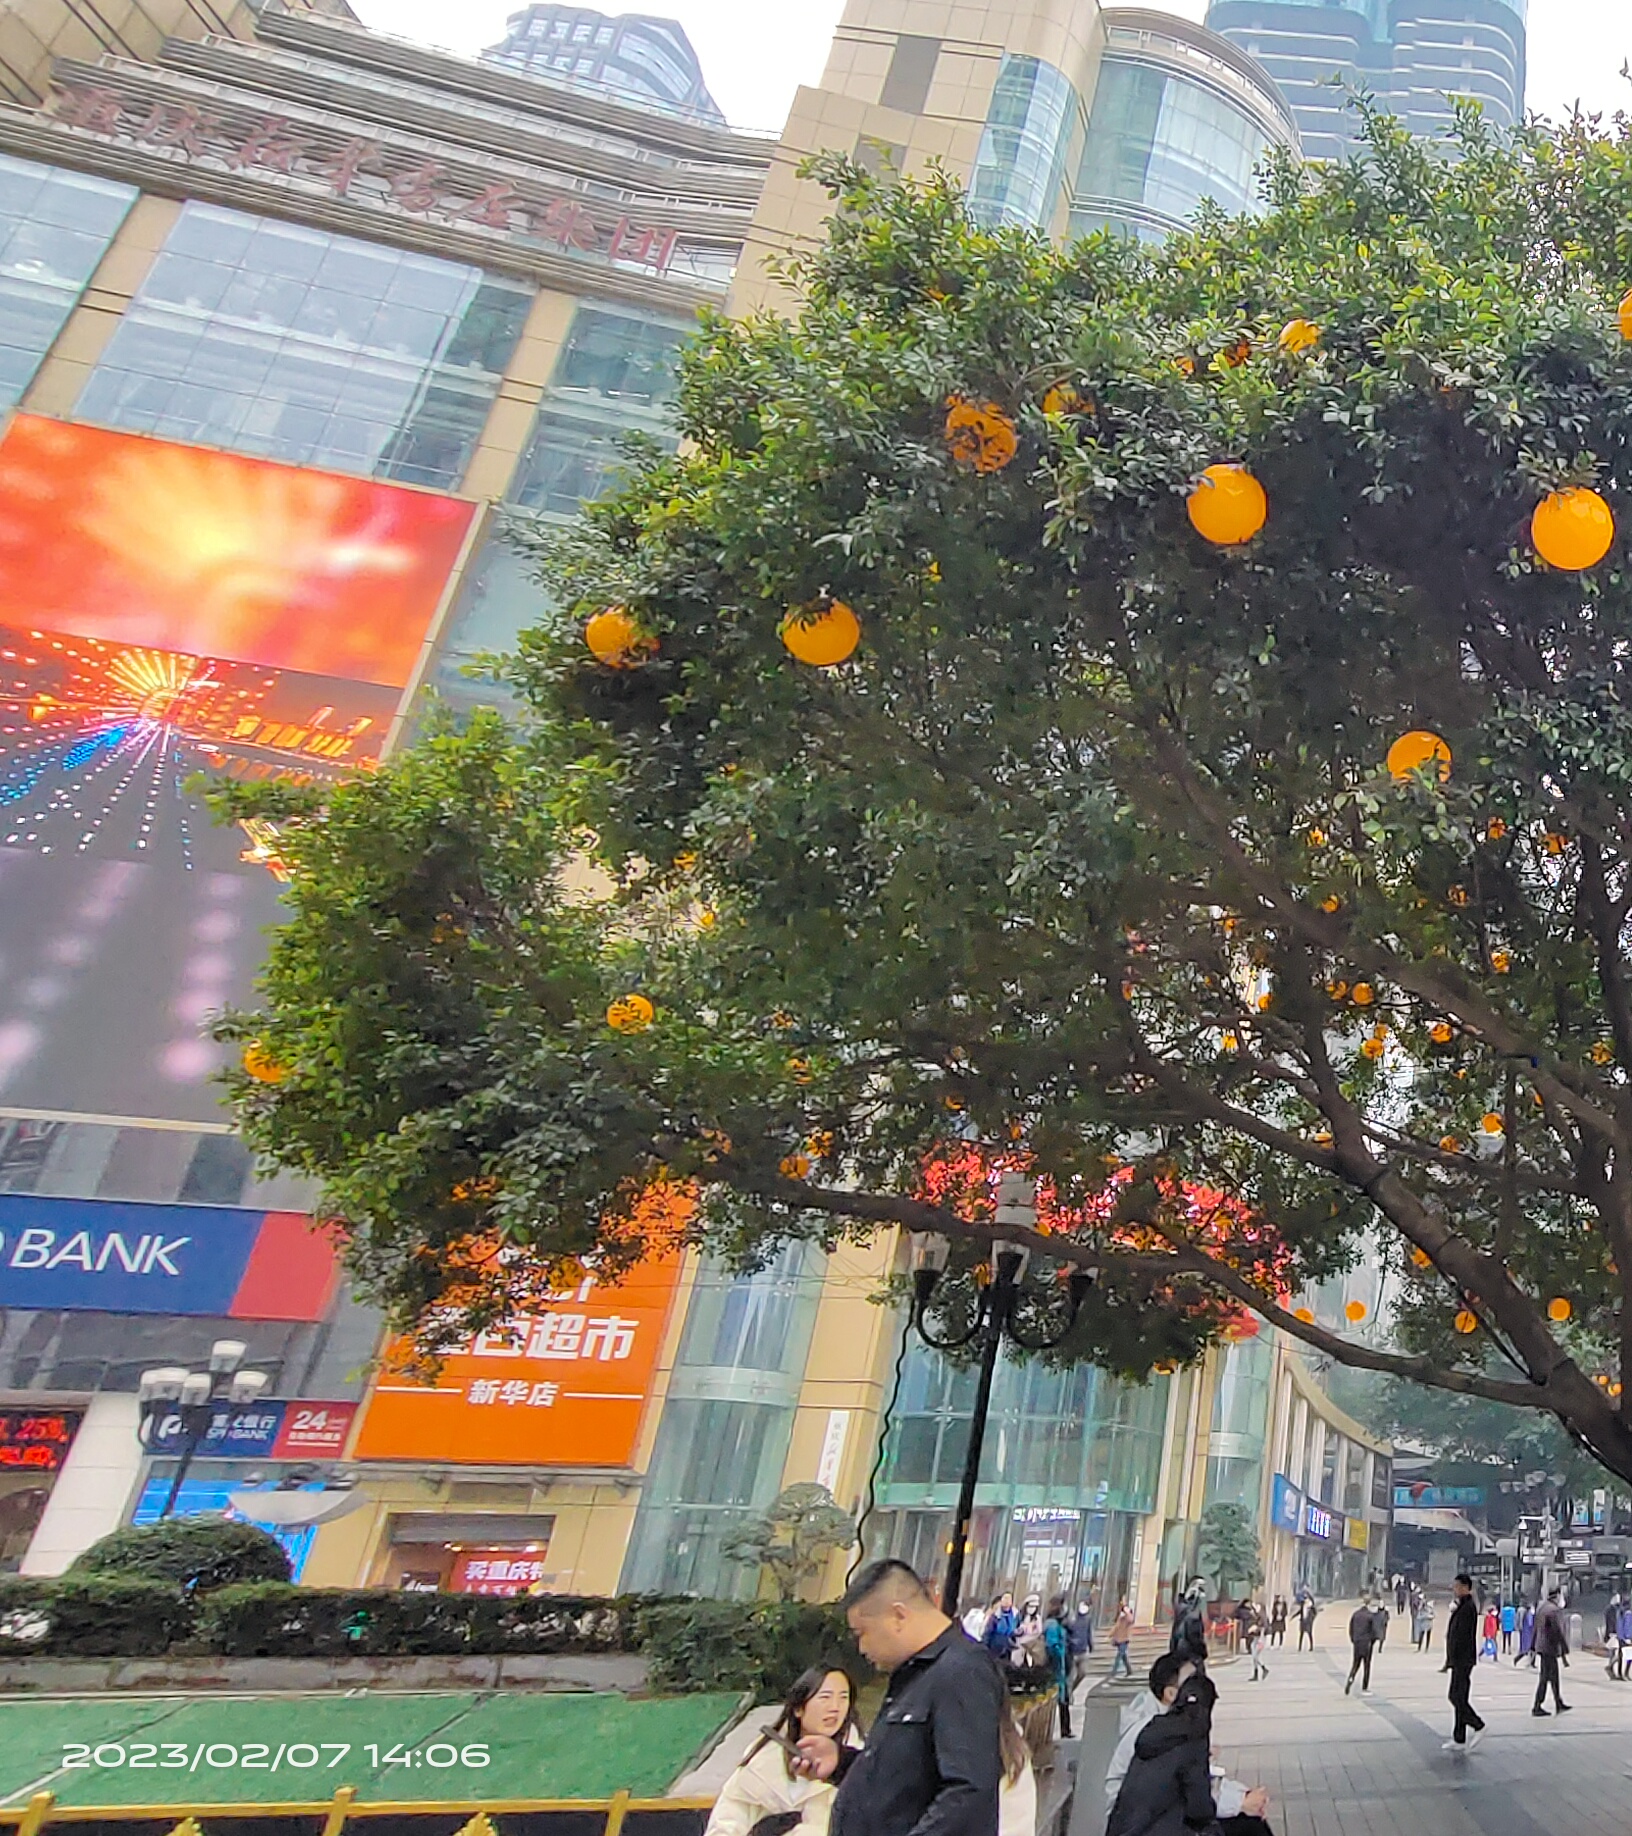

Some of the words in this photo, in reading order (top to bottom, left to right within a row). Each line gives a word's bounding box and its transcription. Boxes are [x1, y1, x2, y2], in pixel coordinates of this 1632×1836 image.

[10, 1228, 192, 1277] BANK
[467, 1379, 559, 1408] 新华店
[292, 1410, 329, 1430] 24
